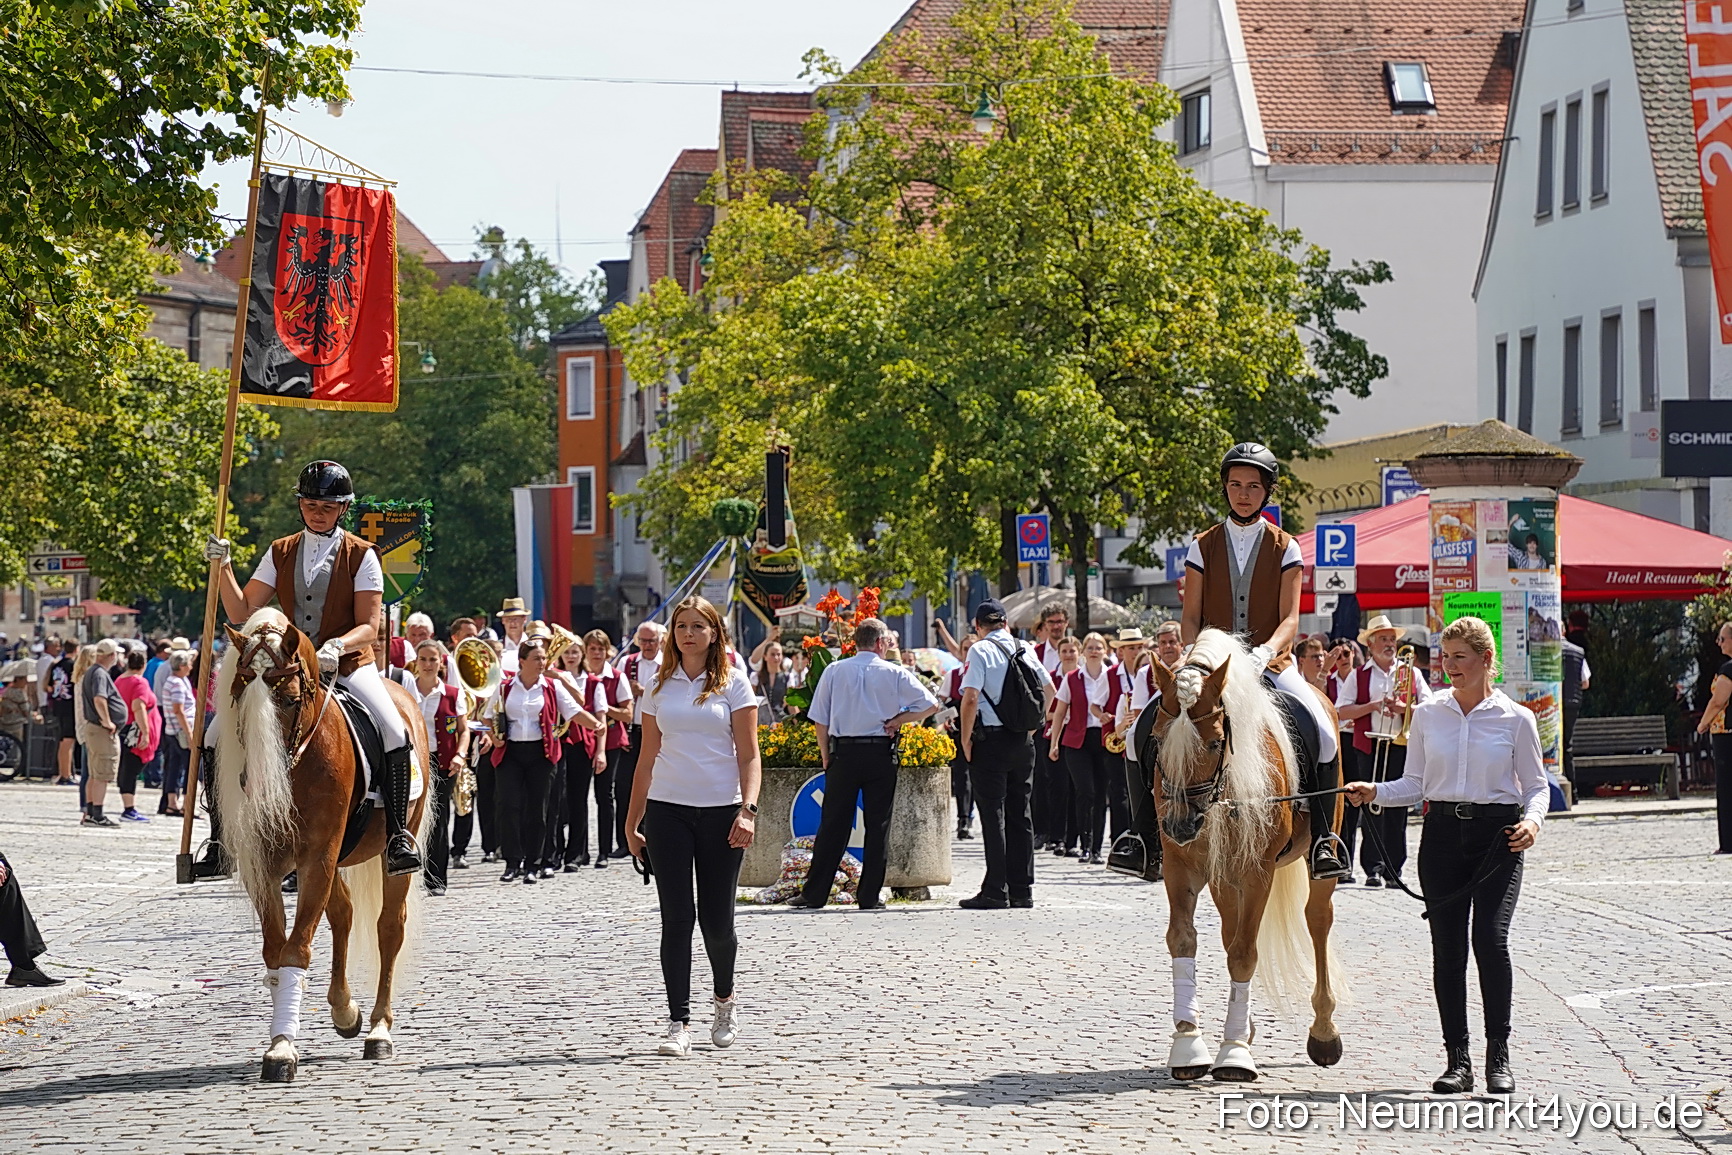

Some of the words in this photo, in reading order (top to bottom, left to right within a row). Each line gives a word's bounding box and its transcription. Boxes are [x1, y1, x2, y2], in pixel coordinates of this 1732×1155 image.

[1021, 546, 1047, 559] TAXI
[1324, 529, 1347, 562] P
[1605, 571, 1641, 584] Hotel
[1644, 571, 1706, 585] Restaura
